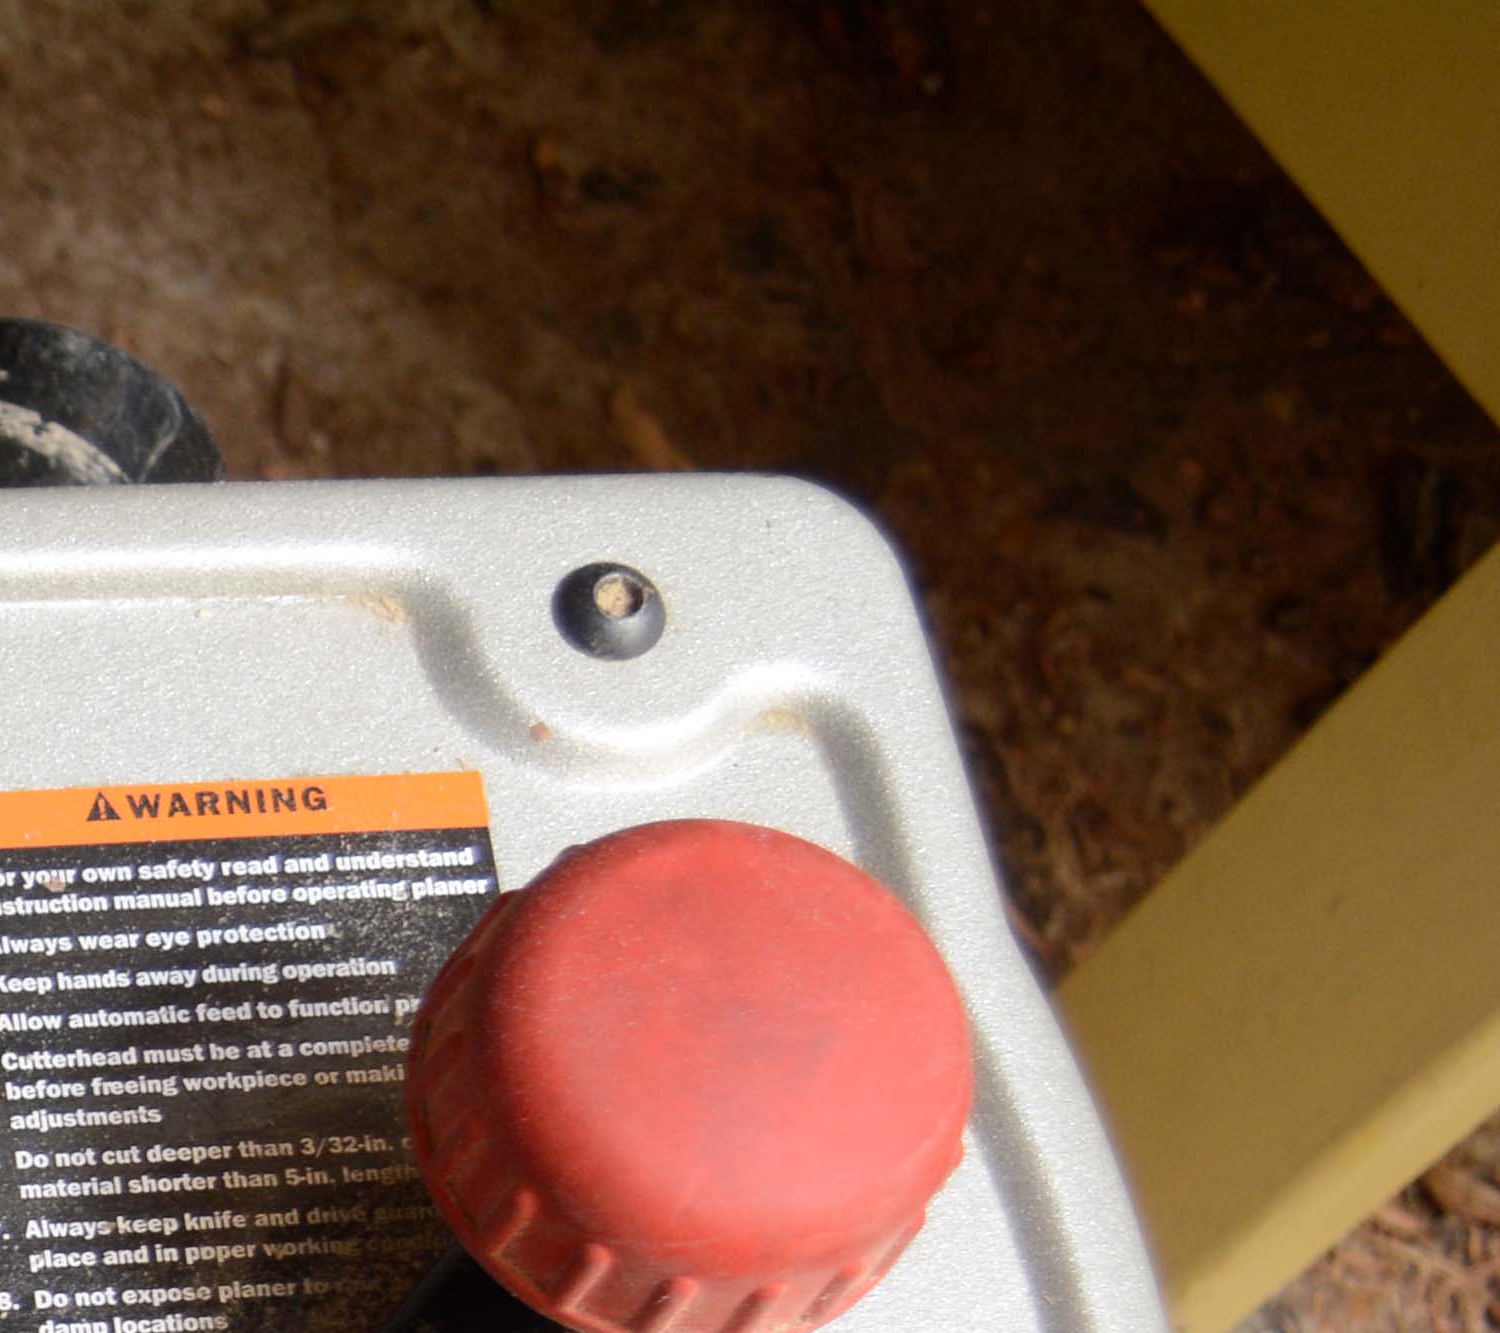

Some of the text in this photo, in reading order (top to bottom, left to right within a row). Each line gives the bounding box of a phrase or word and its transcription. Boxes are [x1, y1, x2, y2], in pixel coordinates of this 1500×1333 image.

[127, 787, 326, 818] WARNING
[21, 868, 77, 891] your
[81, 866, 133, 883] own
[137, 859, 216, 882] safety
[221, 855, 278, 876] read
[283, 853, 331, 874] and
[335, 847, 475, 871] understand
[113, 888, 203, 910] manual
[206, 885, 288, 906] before
[291, 879, 409, 905] operating
[410, 876, 489, 901] planer
[78, 933, 140, 950] wear
[145, 930, 191, 951] eye
[196, 921, 327, 949] protection
[56, 969, 131, 991] hands
[135, 969, 196, 988] away
[201, 962, 279, 984] during
[282, 957, 397, 983] operation
[68, 1005, 191, 1029] automatic
[195, 1001, 252, 1022] feed
[256, 1001, 284, 1019] to
[287, 996, 390, 1018] function
[1, 1046, 138, 1071] Cutterhead
[143, 1044, 205, 1064] must
[208, 1043, 240, 1061] be
[246, 1040, 273, 1059] at
[277, 1043, 294, 1058] a
[298, 1034, 410, 1058] complete
[5, 1070, 307, 1101] before freeing workpiece
[9, 1106, 162, 1133] adjustments
